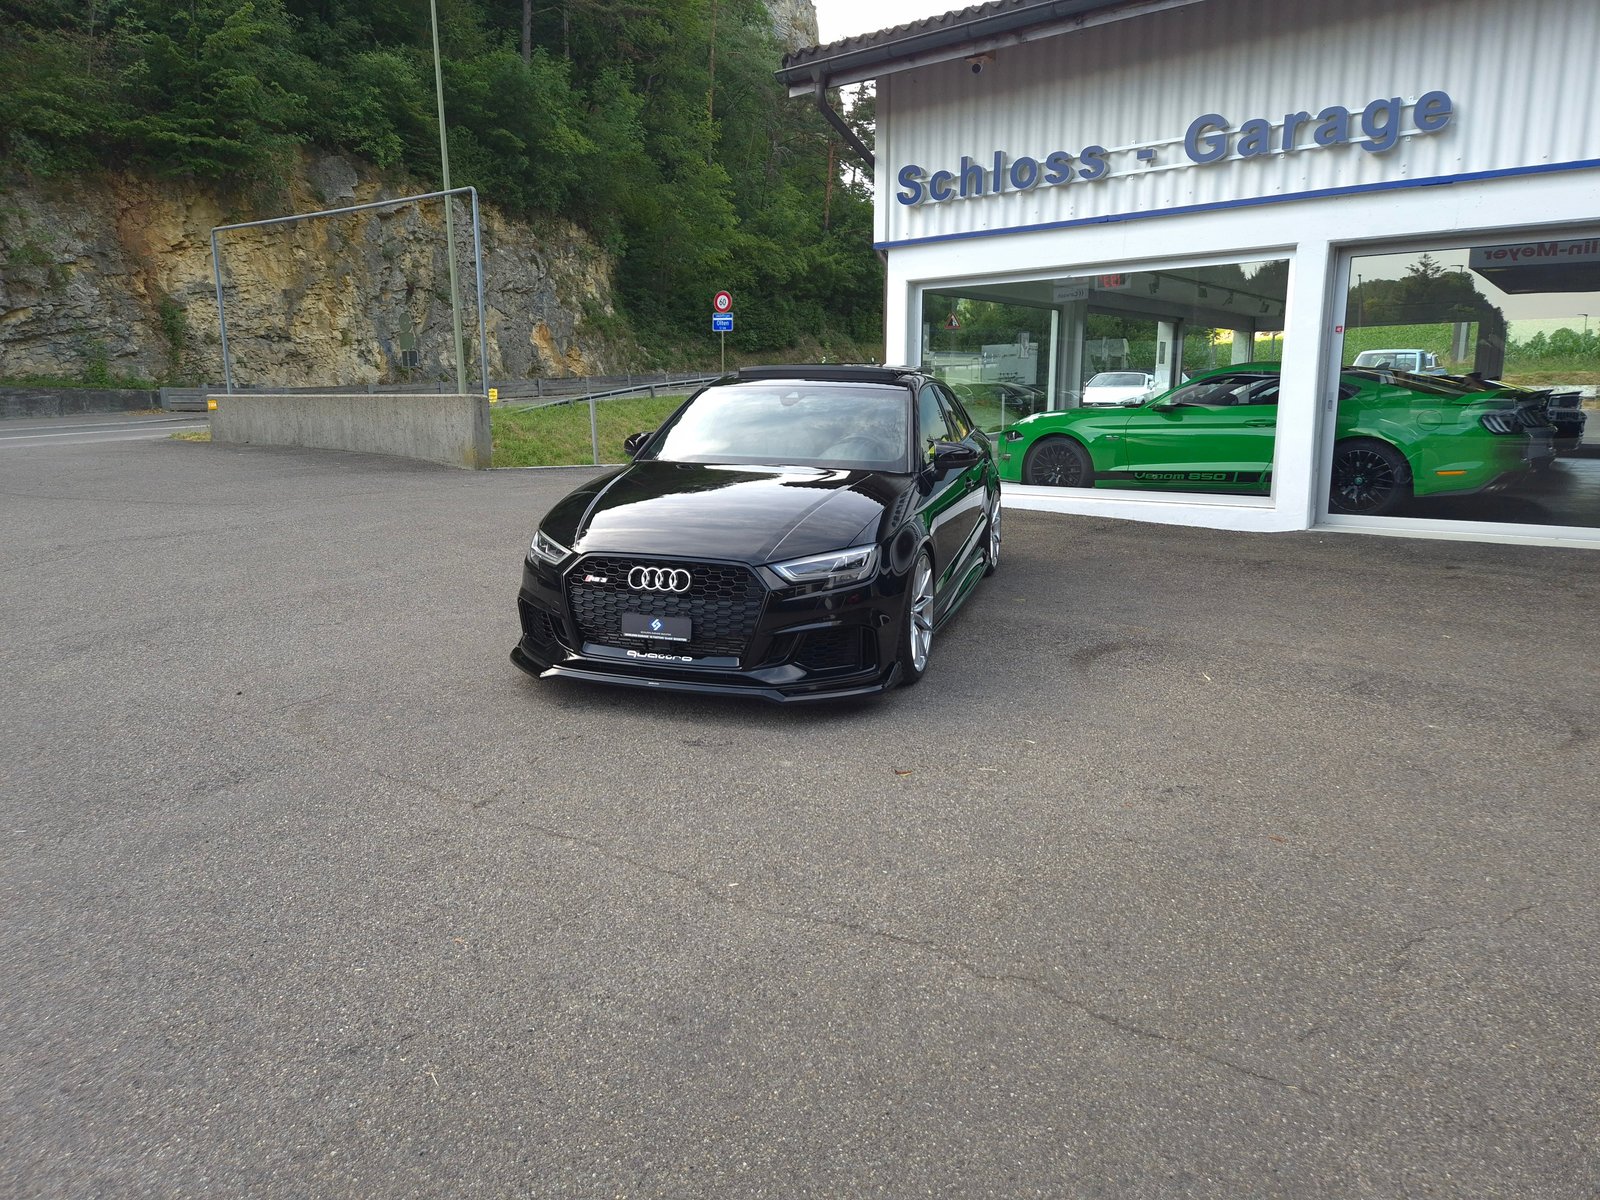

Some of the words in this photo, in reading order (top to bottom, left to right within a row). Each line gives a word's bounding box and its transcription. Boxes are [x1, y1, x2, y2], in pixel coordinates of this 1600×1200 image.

[896, 144, 1109, 207] Schloss
[1184, 89, 1453, 166] Garage
[719, 298, 727, 306] 60
[1134, 471, 1185, 480] Venom
[1188, 472, 1227, 481] 850
[626, 650, 693, 662] quattro
